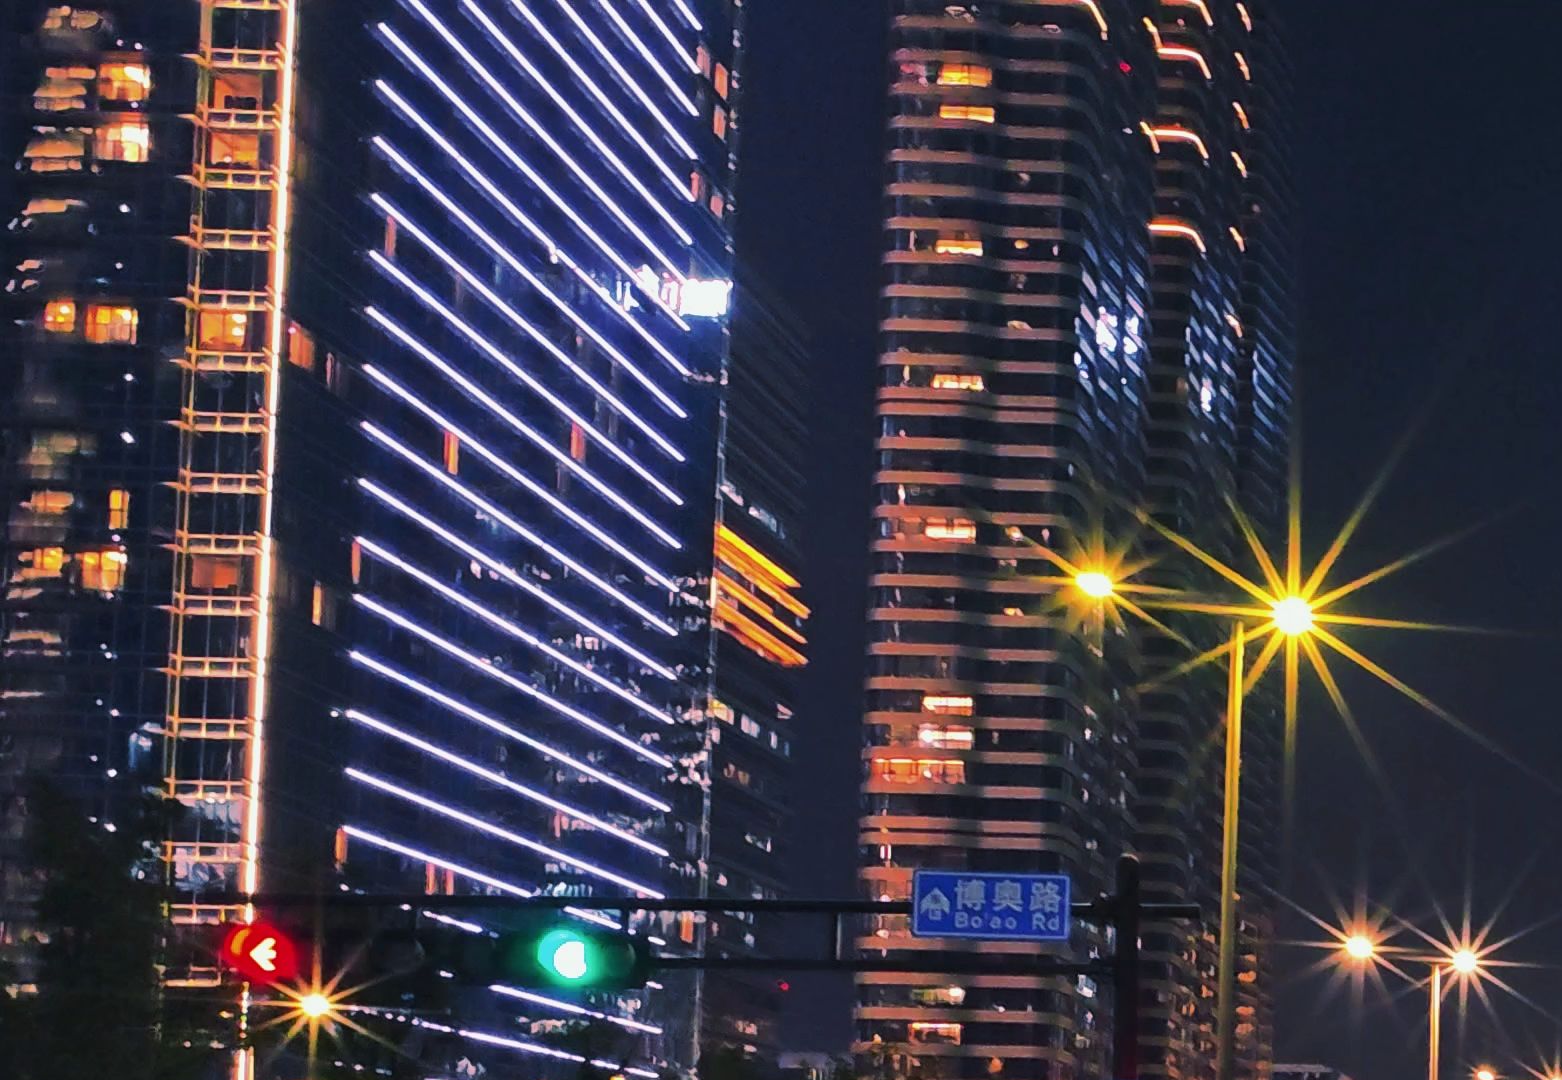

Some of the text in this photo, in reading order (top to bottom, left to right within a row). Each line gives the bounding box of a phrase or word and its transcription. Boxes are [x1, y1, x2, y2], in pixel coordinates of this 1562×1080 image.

[954, 879, 1061, 913] 博奥路
[1032, 912, 1060, 931] Rd
